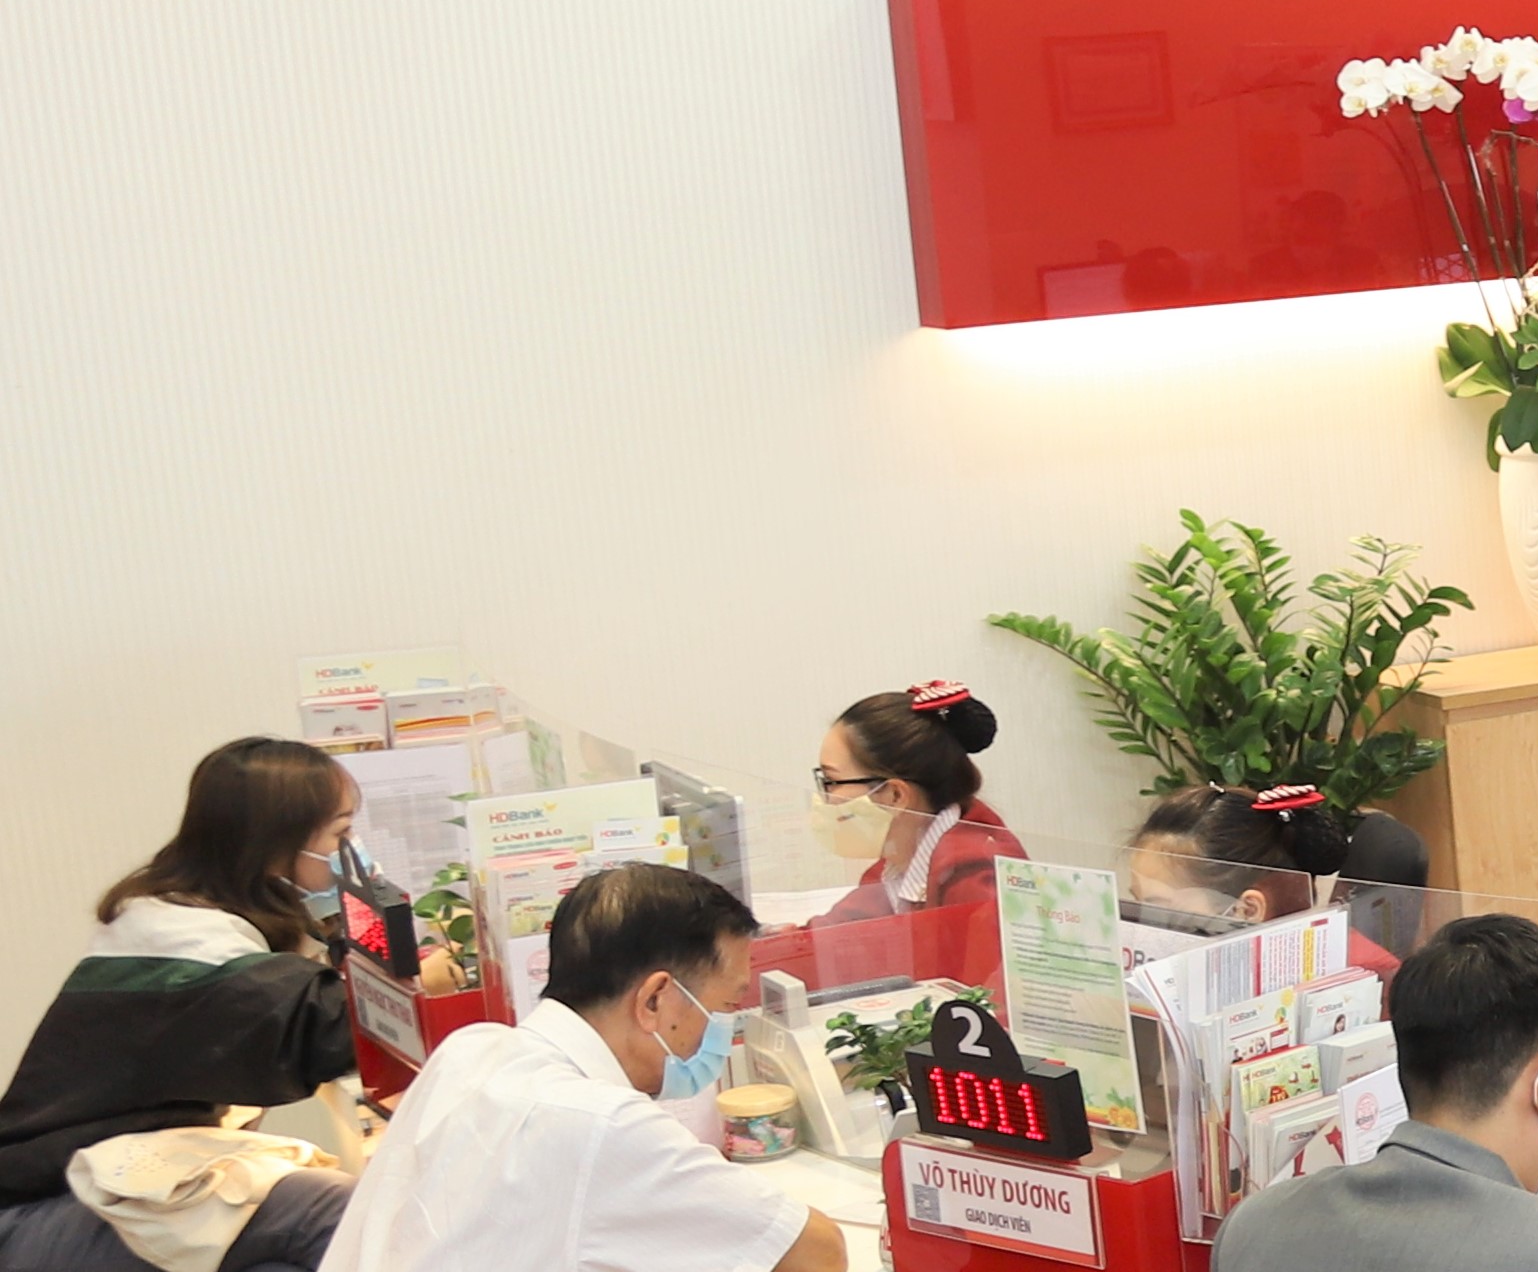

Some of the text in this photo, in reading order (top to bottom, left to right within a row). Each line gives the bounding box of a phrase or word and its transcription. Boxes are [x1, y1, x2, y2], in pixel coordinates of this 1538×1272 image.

[315, 667, 362, 679] HDBank
[489, 807, 544, 823] HDBank
[600, 828, 633, 838] HDBank
[951, 1006, 992, 1058] 2
[929, 1066, 1045, 1141] 1011
[919, 1160, 1071, 1215] VÕ THÙY DƯƠNG
[965, 1207, 987, 1227] GIAO
[1010, 1214, 1032, 1234] VIÊN
